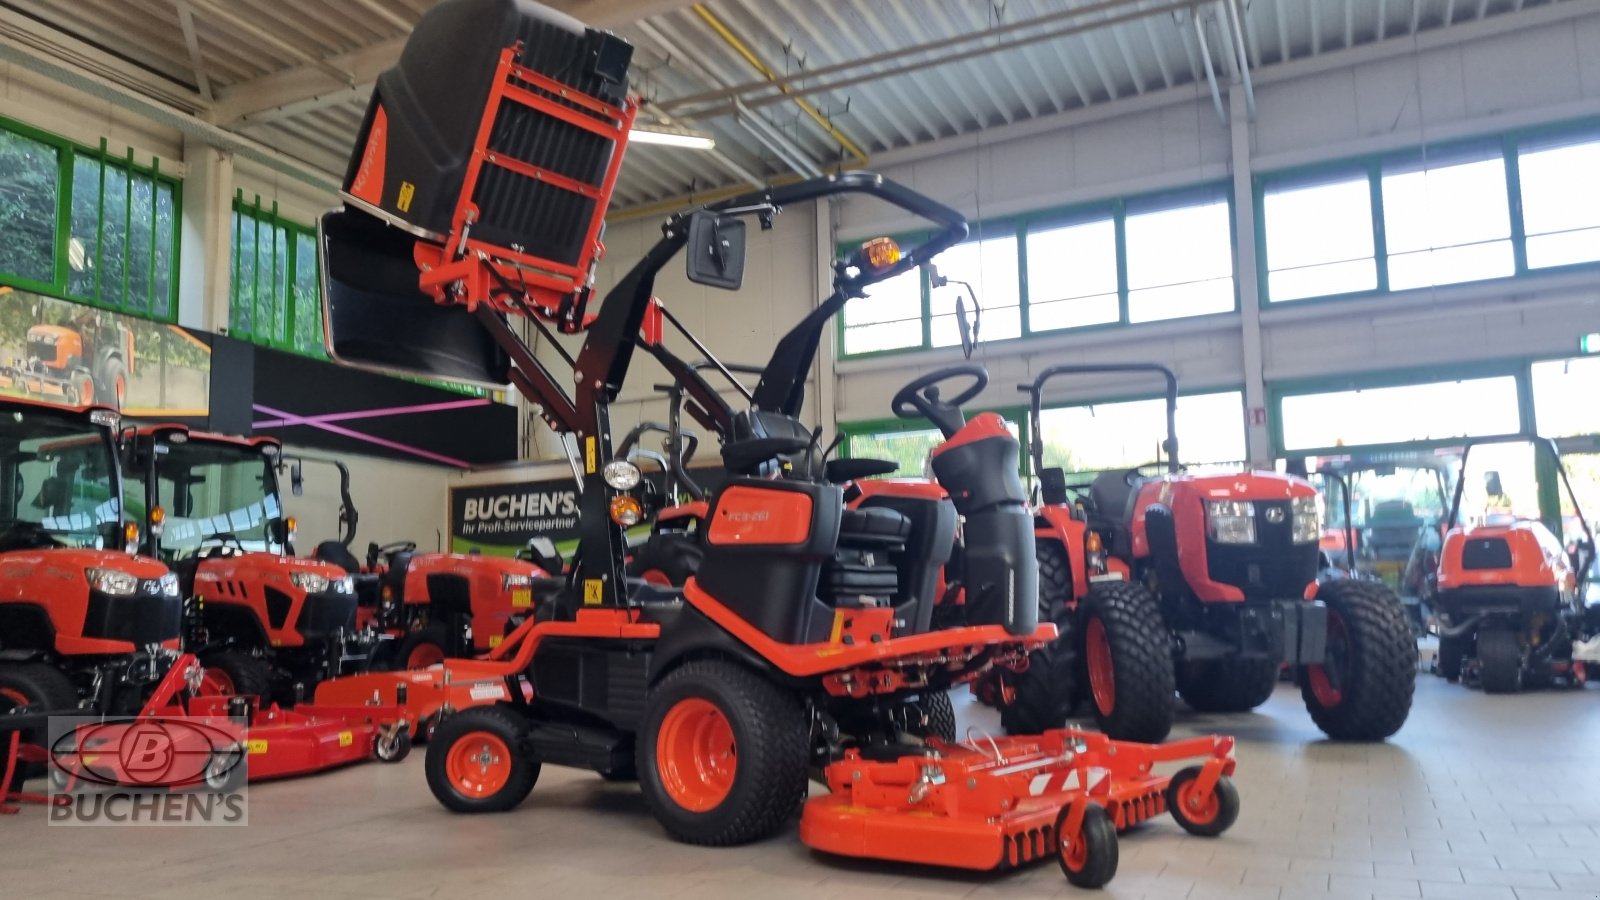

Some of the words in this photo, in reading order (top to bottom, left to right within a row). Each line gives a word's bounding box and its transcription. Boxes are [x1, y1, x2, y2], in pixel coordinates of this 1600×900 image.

[464, 491, 576, 521] BUCHEN'S
[461, 520, 476, 535] Ihr
[477, 517, 576, 534] Profi-Servicepartner
